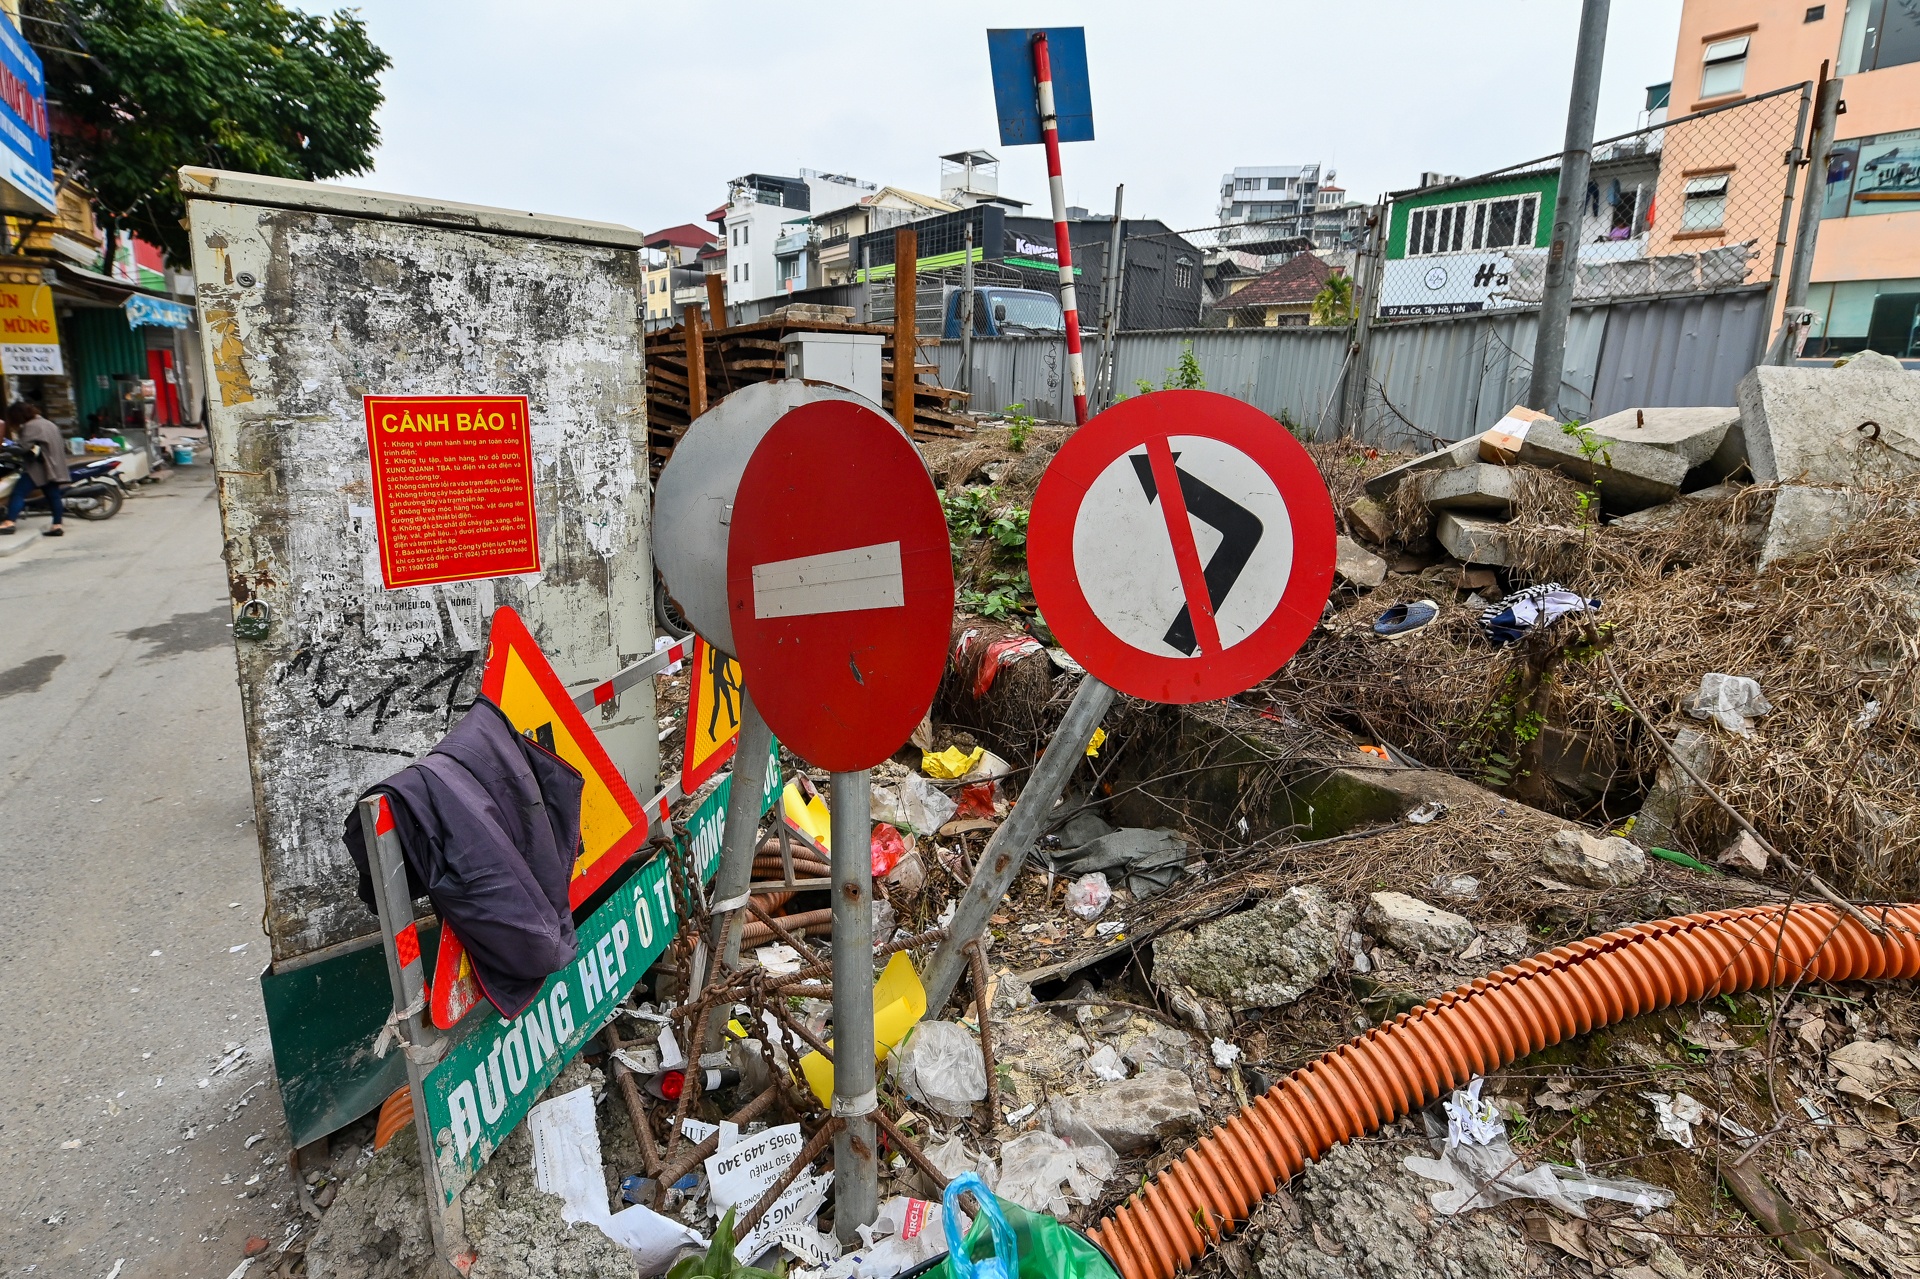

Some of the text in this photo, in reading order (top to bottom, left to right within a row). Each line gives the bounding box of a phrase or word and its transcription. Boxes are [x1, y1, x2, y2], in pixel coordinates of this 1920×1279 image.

[1388, 307, 1398, 315] 97
[382, 408, 516, 432] CẢNH BÁO !
[448, 994, 574, 1161] ĐƯỜNG
[578, 918, 630, 1014] HẸP
[634, 886, 653, 948] Ô
[718, 1132, 797, 1176] 0965.449.340
[775, 1152, 792, 1166] 350
[750, 1160, 774, 1179] TRIỆU
[744, 1192, 760, 1207] RỘNG
